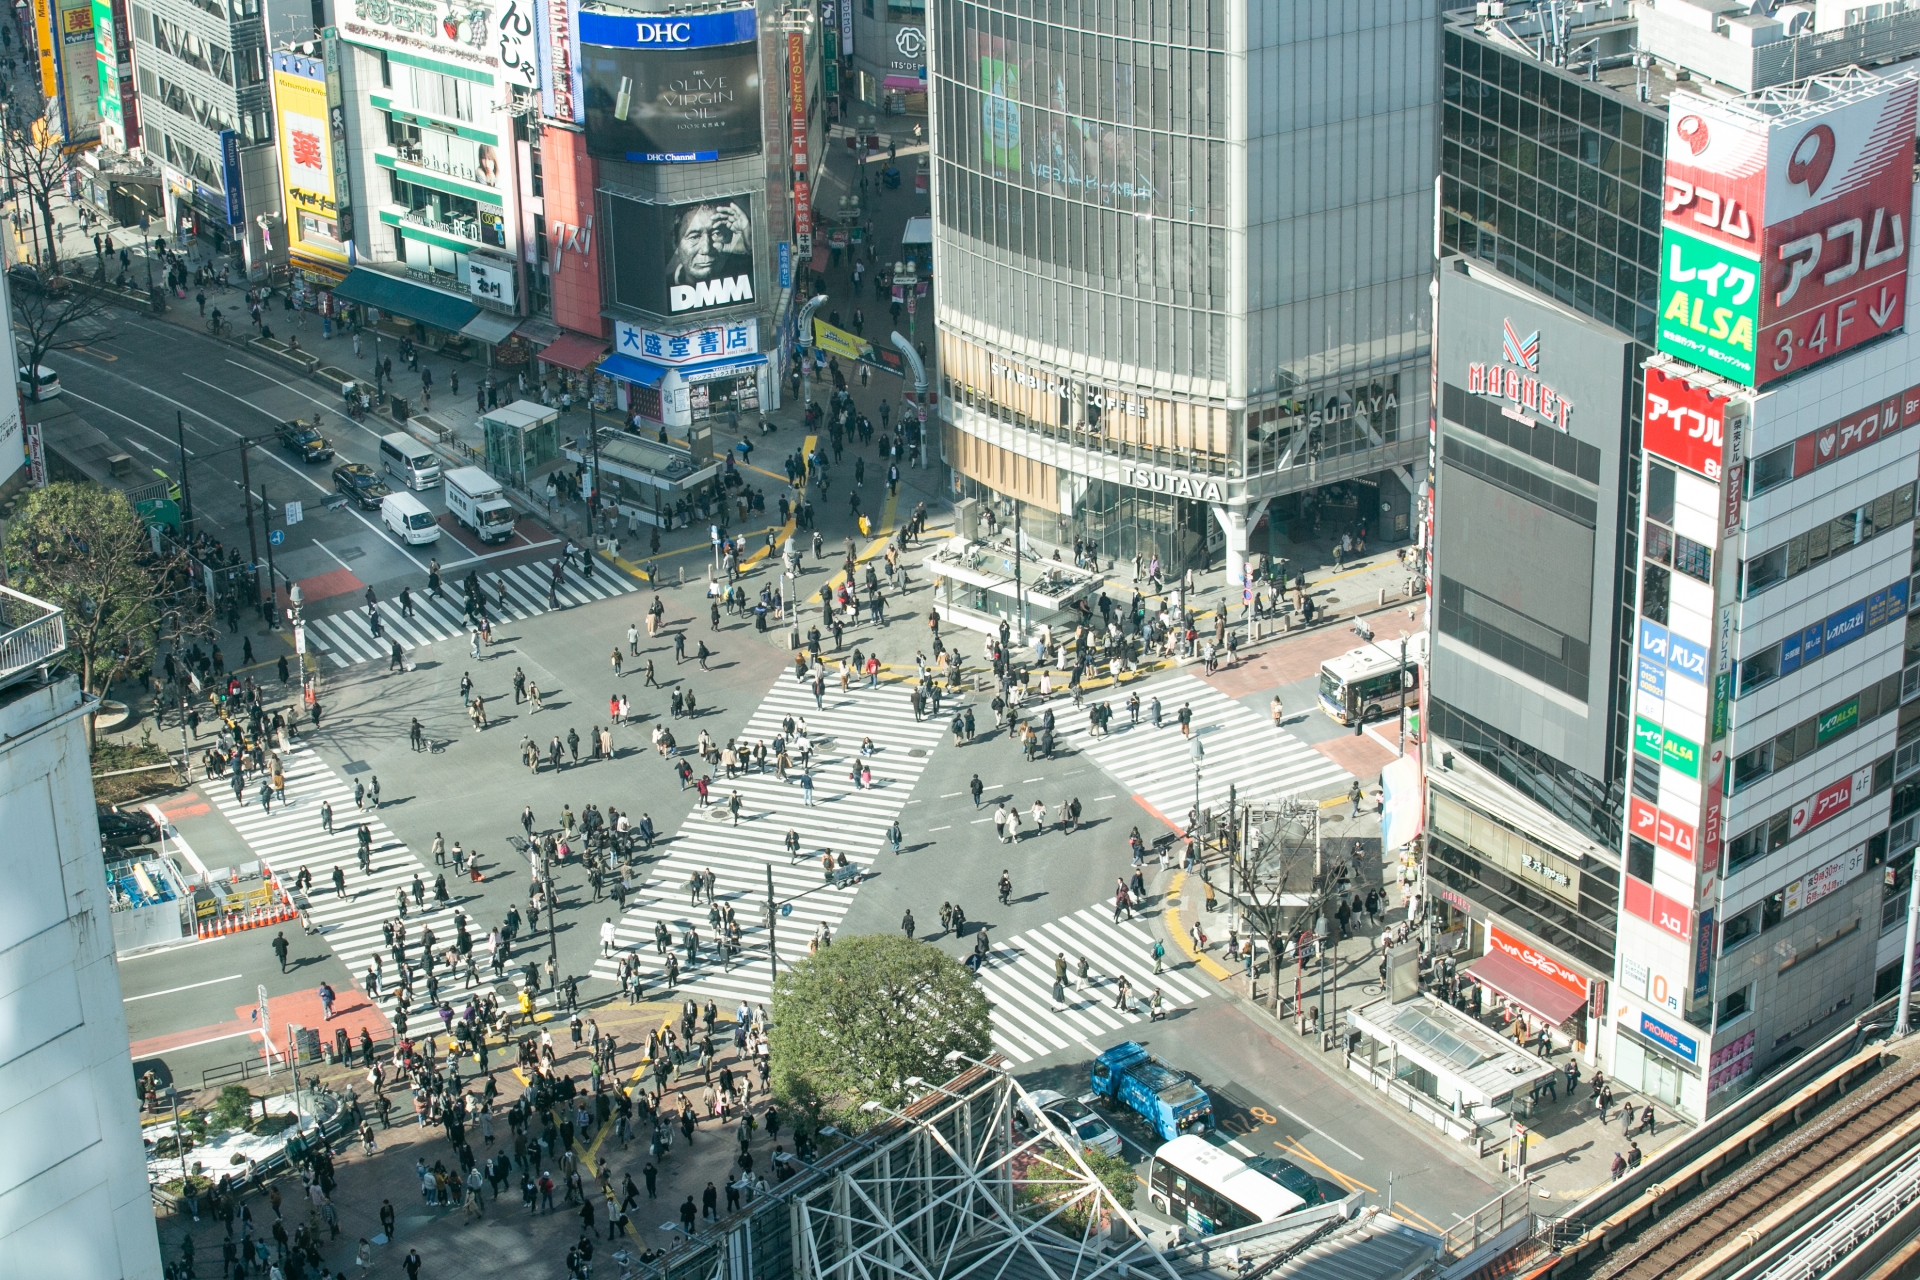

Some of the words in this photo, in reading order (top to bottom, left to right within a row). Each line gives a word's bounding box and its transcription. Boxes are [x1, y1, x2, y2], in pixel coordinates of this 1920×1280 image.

[68, 9, 91, 29] 薬
[636, 23, 690, 42] DHC
[792, 36, 803, 113] クスリのことなら
[891, 61, 926, 71] ITS'DEM
[279, 79, 310, 93] Matsumoto
[311, 89, 327, 97] KiYos
[663, 90, 733, 106] VIRGIN
[669, 77, 727, 92] OLIVE
[684, 108, 717, 120] OIL
[228, 138, 236, 166] MIZUHO
[291, 130, 322, 170] 薬
[665, 151, 696, 161] Channel
[793, 118, 807, 165] 三千里
[401, 146, 473, 177] Euphoria
[1665, 176, 1750, 239] アコム
[1776, 207, 1904, 307] アコム
[1670, 244, 1755, 305] レイク
[670, 274, 753, 312] DMM
[1664, 290, 1753, 352] ALSA
[623, 326, 747, 358] 大盛堂書店
[1087, 391, 1146, 417] COFFEE
[1294, 393, 1398, 431] TSUTAYA
[1468, 362, 1573, 435] MAGNET
[1648, 393, 1722, 447] アイフル
[1841, 406, 1898, 450] アイフル
[1122, 466, 1222, 501] TSUTAYA
[1728, 480, 1739, 526] アイフル
[1643, 631, 1704, 676] レオパレス
[1718, 676, 1727, 701] レイク
[1715, 700, 1724, 734] ALSA
[1819, 715, 1837, 733] レイク
[1837, 705, 1857, 723] ALSA
[1637, 724, 1662, 745] レイク
[1664, 740, 1693, 761] ALSA
[1819, 789, 1848, 814] アコム
[1638, 808, 1691, 851] アコム
[1707, 805, 1719, 843] アコム
[1849, 854, 1862, 871] 3F
[1660, 912, 1681, 933] 入口
[1699, 924, 1710, 973] PROMISE
[1644, 1020, 1679, 1047] PROMISE
